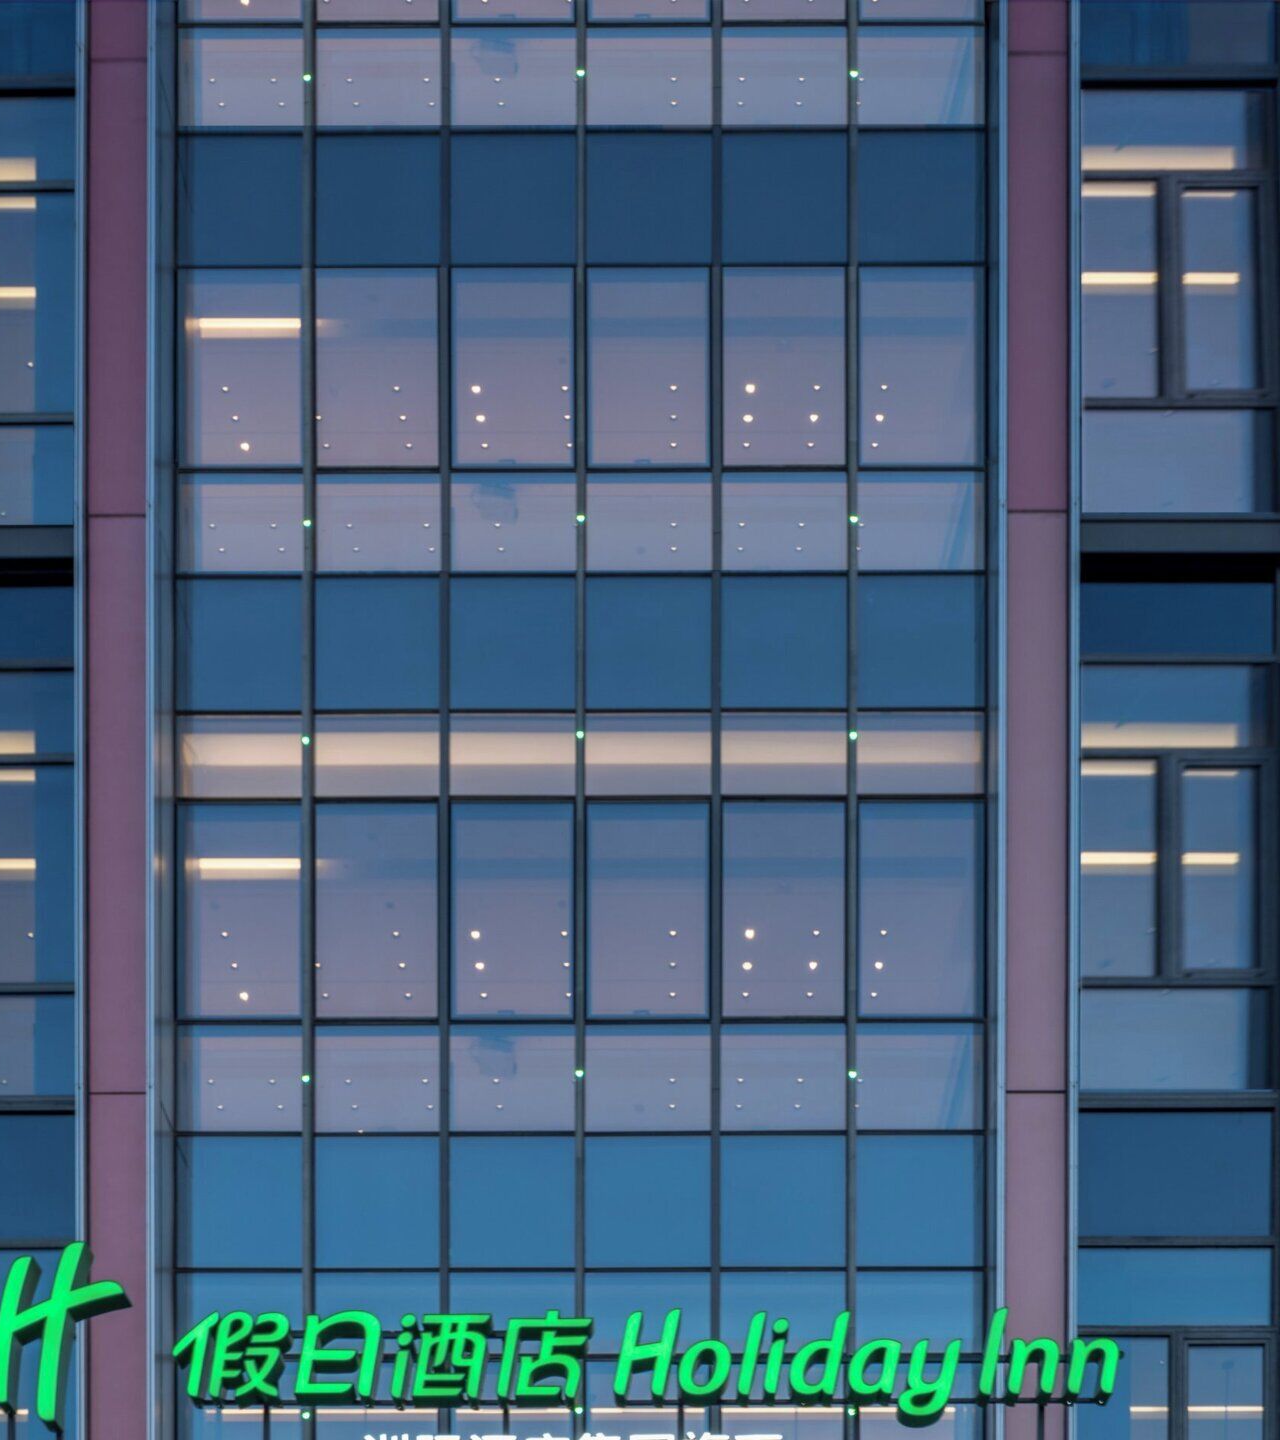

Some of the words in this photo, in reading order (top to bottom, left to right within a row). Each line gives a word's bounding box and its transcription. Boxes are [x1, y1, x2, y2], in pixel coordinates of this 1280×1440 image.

[171, 1308, 594, 1401] 假日酒店
[612, 1307, 962, 1421] Holiday
[977, 1306, 1122, 1400] Inn
